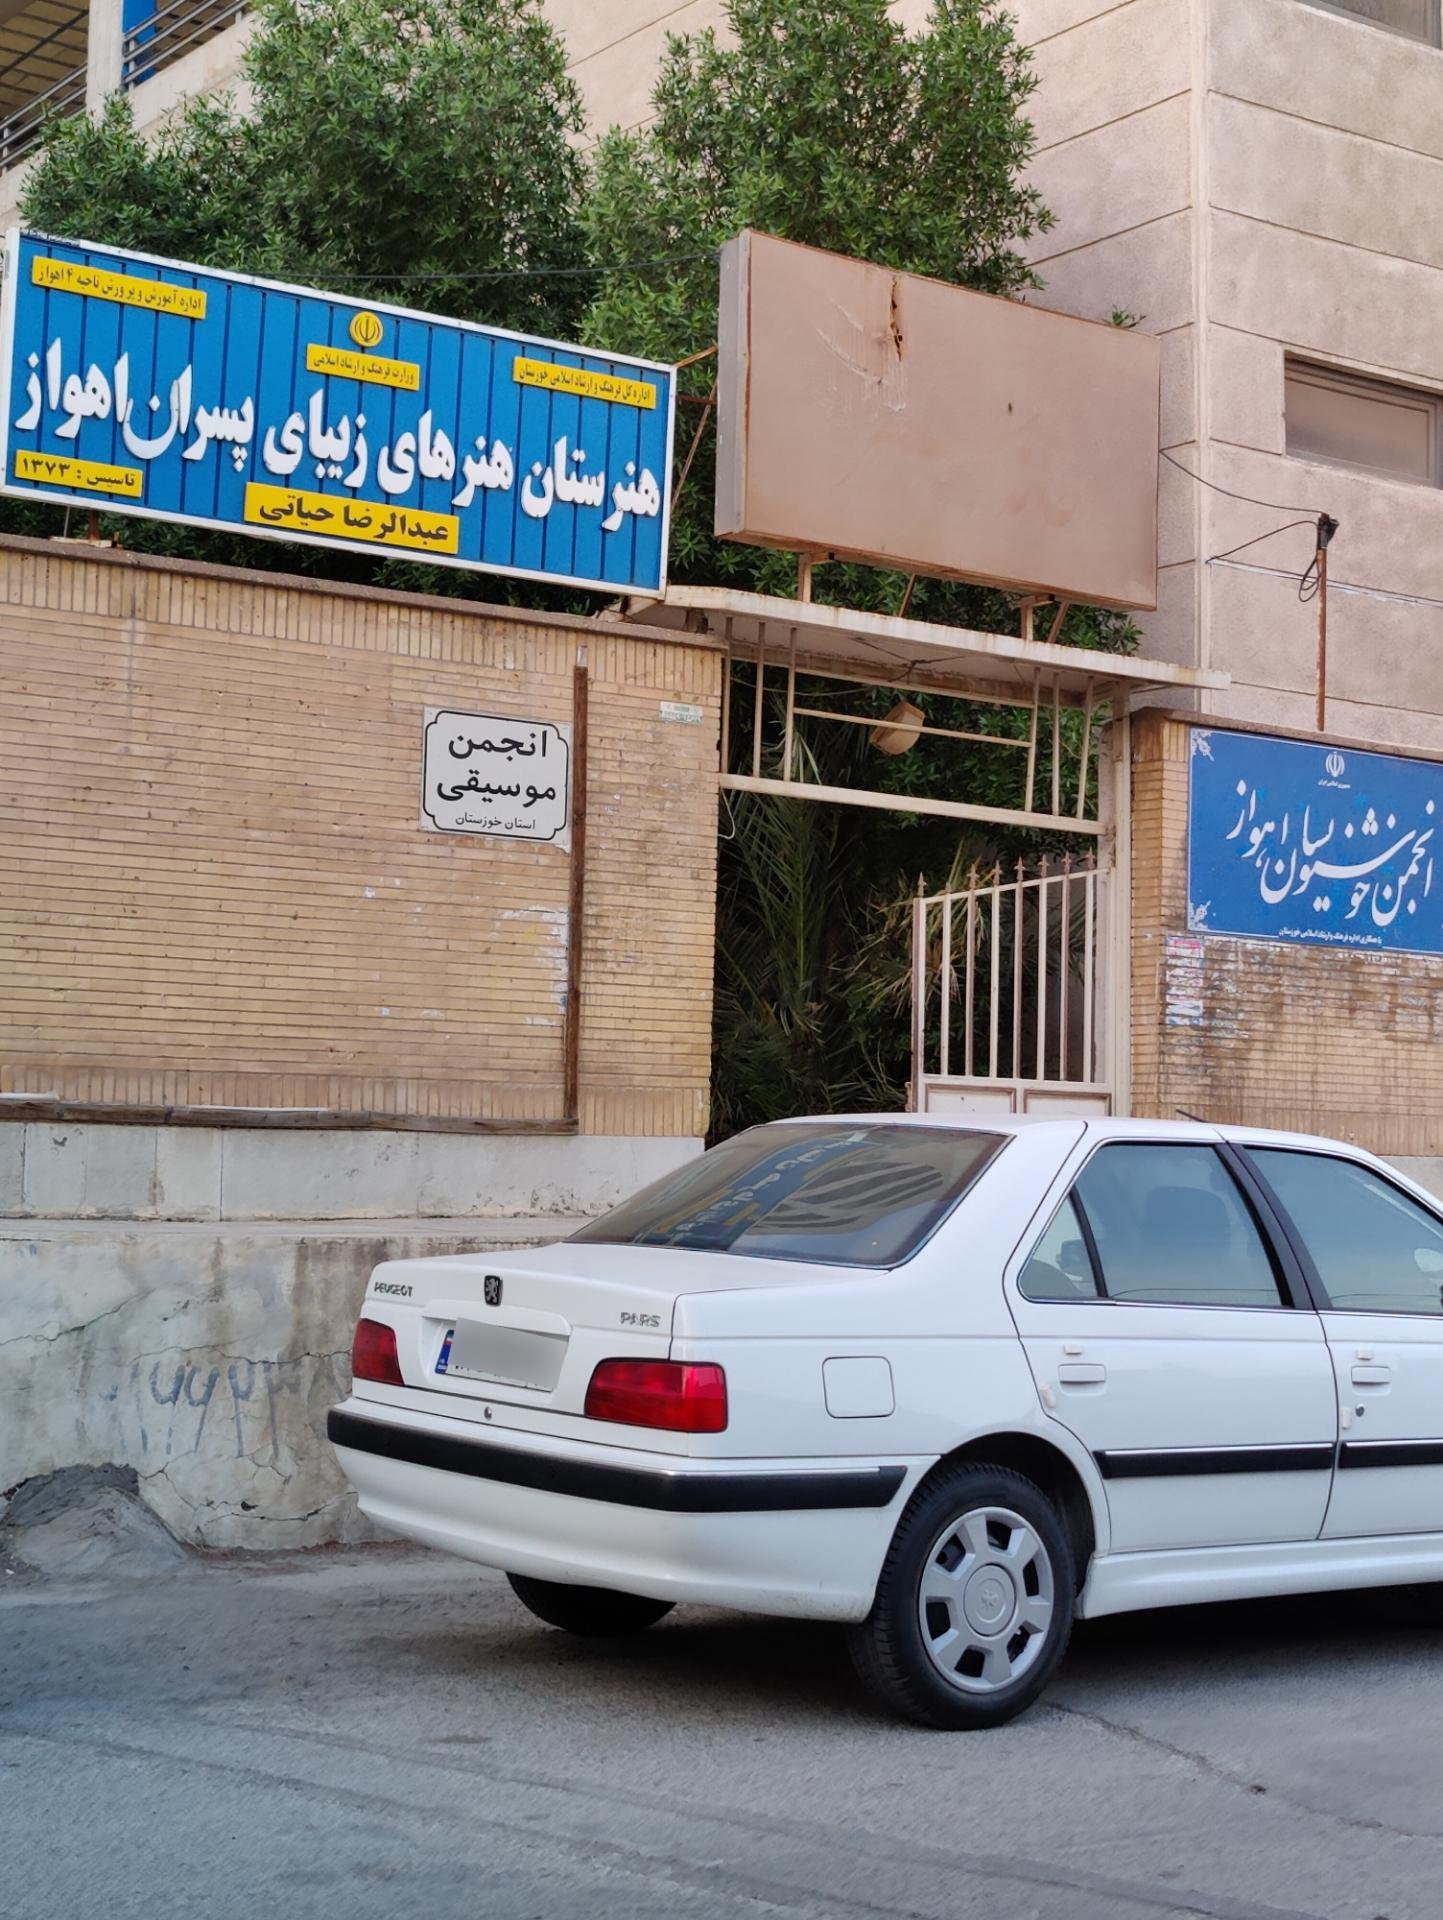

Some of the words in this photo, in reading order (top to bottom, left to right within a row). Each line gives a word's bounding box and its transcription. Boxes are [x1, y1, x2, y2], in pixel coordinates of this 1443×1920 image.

[38, 264, 64, 284] اهواز
[77, 274, 99, 290] ناحیه
[137, 289, 143, 302] و
[145, 288, 178, 308] آموزش
[180, 295, 201, 312] اداره
[313, 352, 339, 367] اسلامی
[367, 362, 390, 379] فرهنگ
[392, 368, 414, 385] وزارت
[519, 363, 548, 383] خوزستان
[550, 370, 574, 386] اسلامی
[14, 337, 130, 439] اهواز
[600, 380, 622, 399] فرهنگ
[122, 363, 255, 473] پسران
[263, 389, 368, 488] زیبای
[23, 457, 71, 478] ۱۳۷۳
[520, 435, 661, 532] هنرستان
[259, 494, 335, 527] حیاتی
[343, 505, 449, 545] عبدالرضا
[448, 730, 548, 762] انجمن
[437, 769, 556, 808] موسیقی
[455, 811, 502, 829] خوزستان
[504, 816, 536, 830] استان
[1225, 779, 1289, 867] اهواز
[1371, 799, 1435, 926] انجمن
[374, 1281, 413, 1297] PEUGEOT
[620, 1311, 661, 1328] PARS
